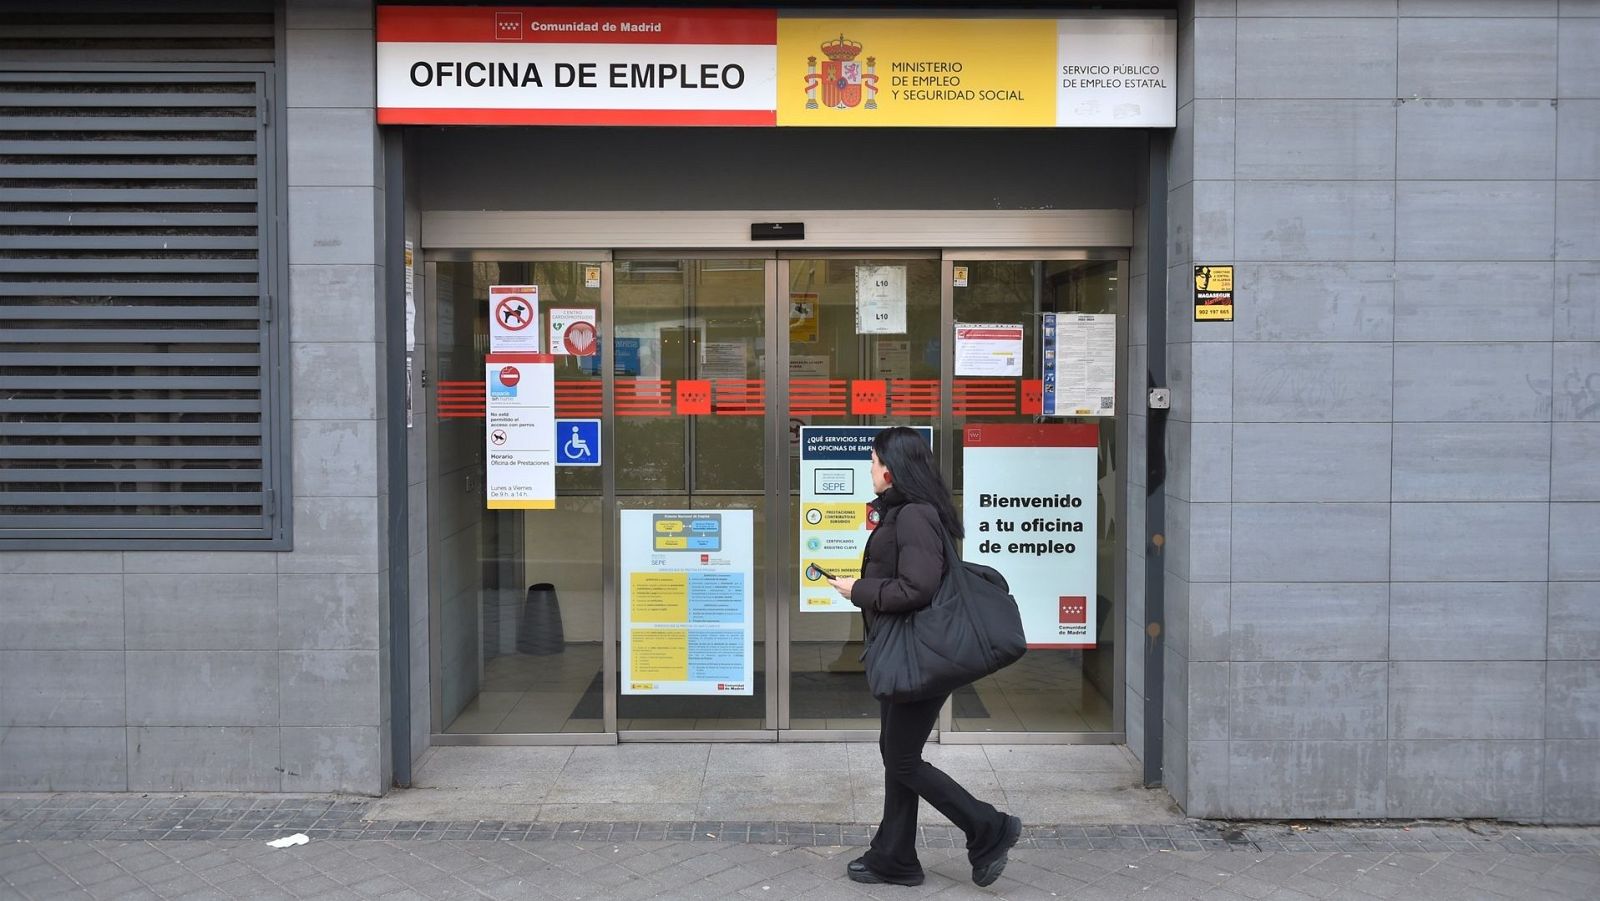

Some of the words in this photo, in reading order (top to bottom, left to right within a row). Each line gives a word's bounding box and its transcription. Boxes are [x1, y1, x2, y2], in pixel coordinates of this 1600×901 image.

[531, 21, 599, 33] Comunidad
[601, 22, 617, 33] de
[620, 22, 662, 33] Madrid
[891, 61, 963, 73] MINISTERIO
[1062, 65, 1110, 76] SERVICIO
[1113, 63, 1160, 76] PÚBLICO
[409, 61, 543, 88] OFICINA
[555, 63, 597, 88] DE
[609, 63, 745, 90] EMPLEO
[892, 76, 909, 87] DE
[912, 76, 960, 87] EMPLEO
[1062, 78, 1077, 89] DE
[1080, 79, 1122, 89] EMPLEO
[1125, 79, 1167, 89] ESTATAL
[891, 90, 900, 101] Y
[903, 90, 975, 101] SEGURIDAD
[978, 90, 1025, 101] SOCIAL
[807, 435, 824, 444] ¿QUÉ
[822, 482, 846, 491] SEPE
[979, 494, 1083, 508] Bienvenido
[979, 521, 990, 532] a
[996, 519, 1014, 532] tu
[1021, 518, 1084, 532] oficina
[979, 540, 1001, 553] de
[1008, 540, 1076, 556] empleo
